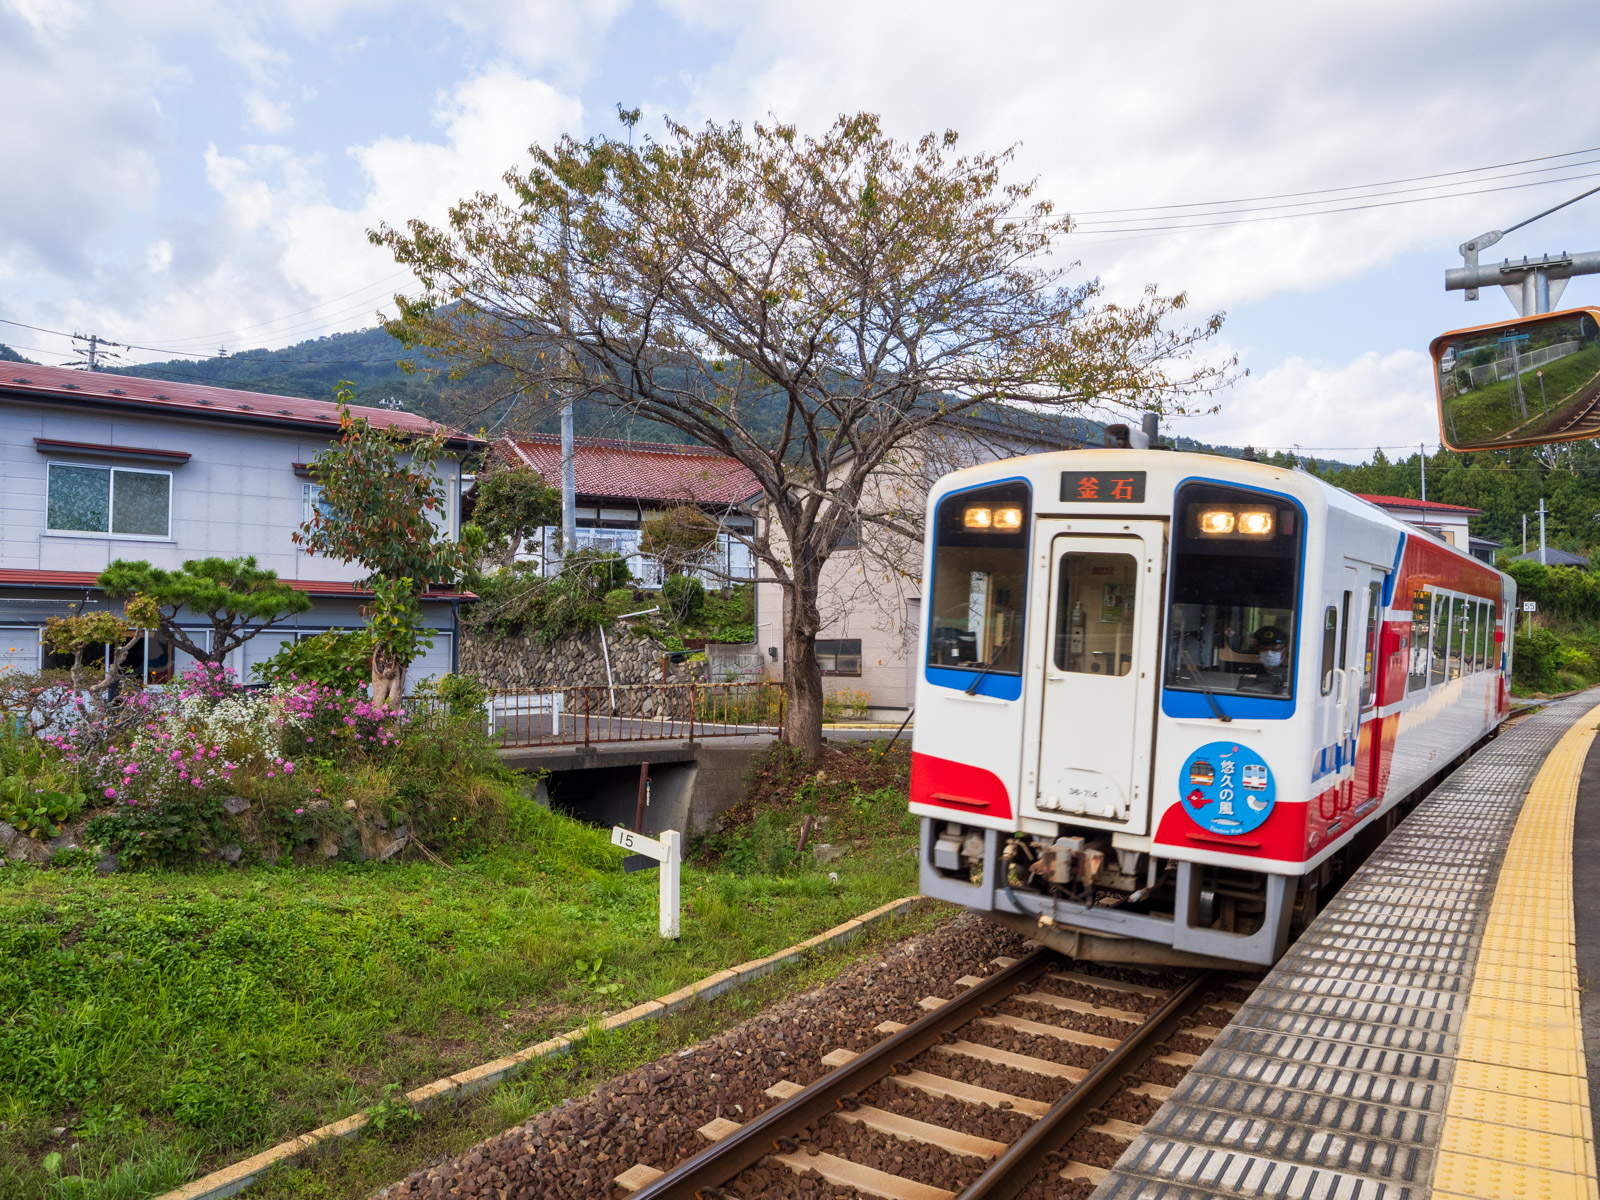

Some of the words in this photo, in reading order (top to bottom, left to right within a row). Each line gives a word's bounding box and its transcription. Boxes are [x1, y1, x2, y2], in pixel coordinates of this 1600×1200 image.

[1076, 476, 1134, 500] 釜石
[1525, 603, 1534, 611] 55
[1218, 760, 1235, 815] 悠久の風
[620, 832, 633, 847] 15
